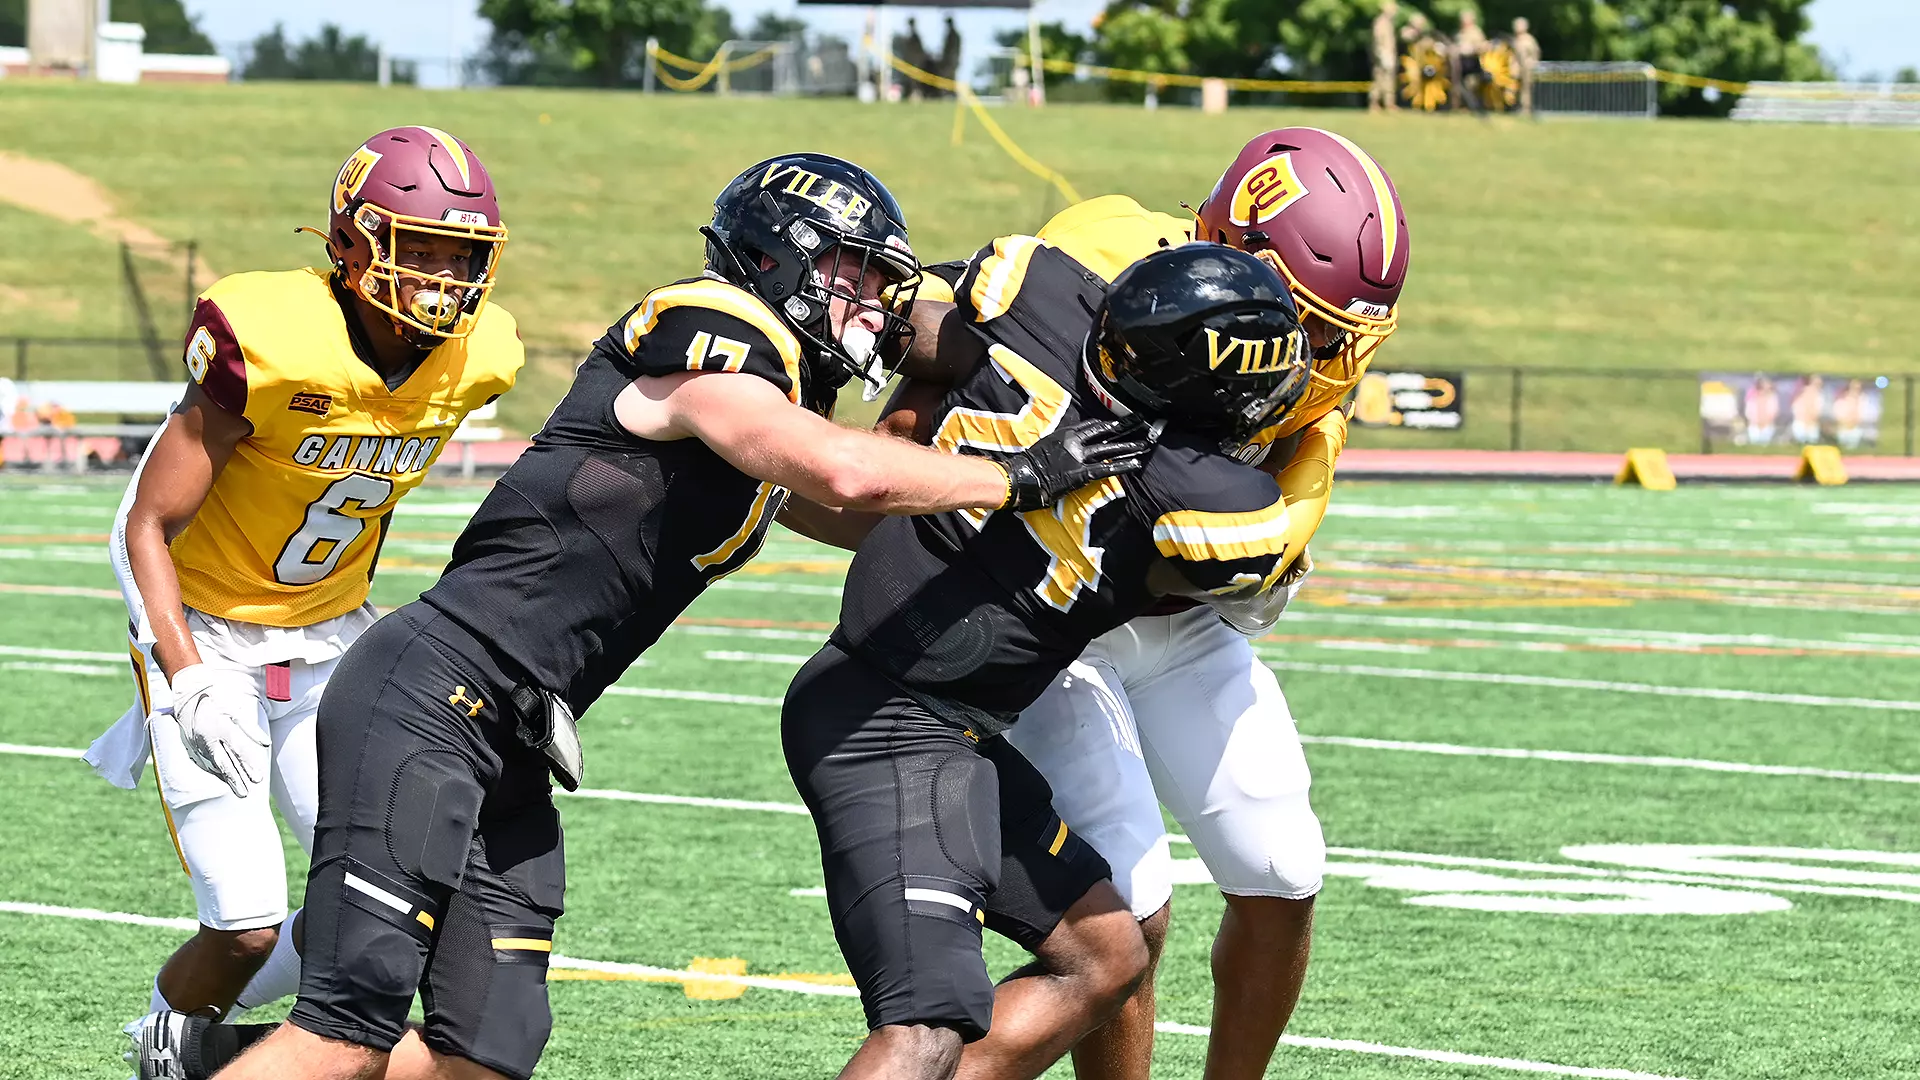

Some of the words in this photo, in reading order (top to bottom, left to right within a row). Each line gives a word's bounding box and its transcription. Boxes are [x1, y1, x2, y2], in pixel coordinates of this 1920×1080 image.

[339, 157, 367, 189] GU
[1247, 166, 1288, 211] GU
[760, 163, 872, 230] VILLE
[186, 326, 216, 385] 6
[684, 330, 752, 374] 17
[289, 396, 332, 411] PSAC
[292, 434, 441, 474] GANNON
[272, 471, 394, 586] 6
